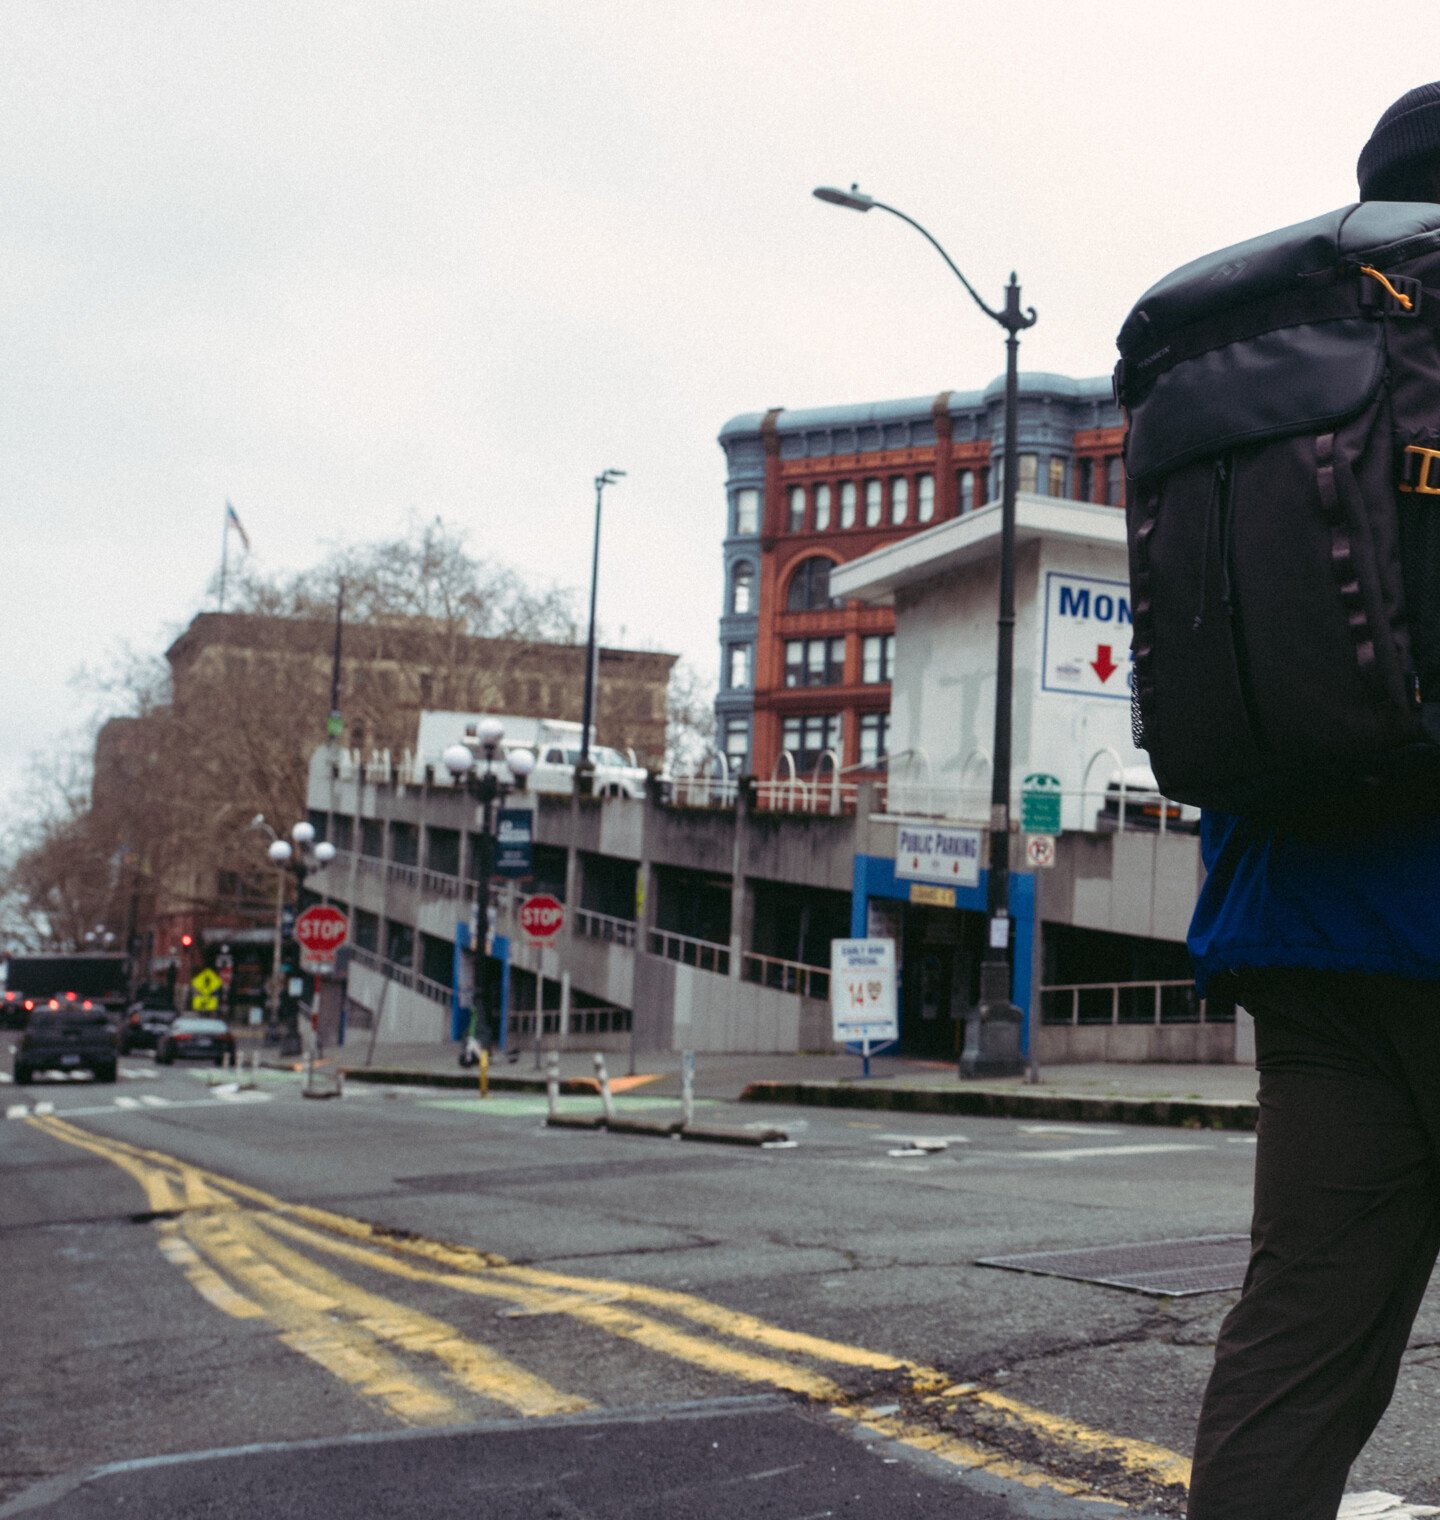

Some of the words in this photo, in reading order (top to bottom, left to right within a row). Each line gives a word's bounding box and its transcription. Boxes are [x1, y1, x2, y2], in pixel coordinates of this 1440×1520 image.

[901, 831, 932, 854] PUBLIC
[936, 833, 977, 858] PARKING
[523, 907, 562, 927] STOP
[300, 919, 345, 940] STOP
